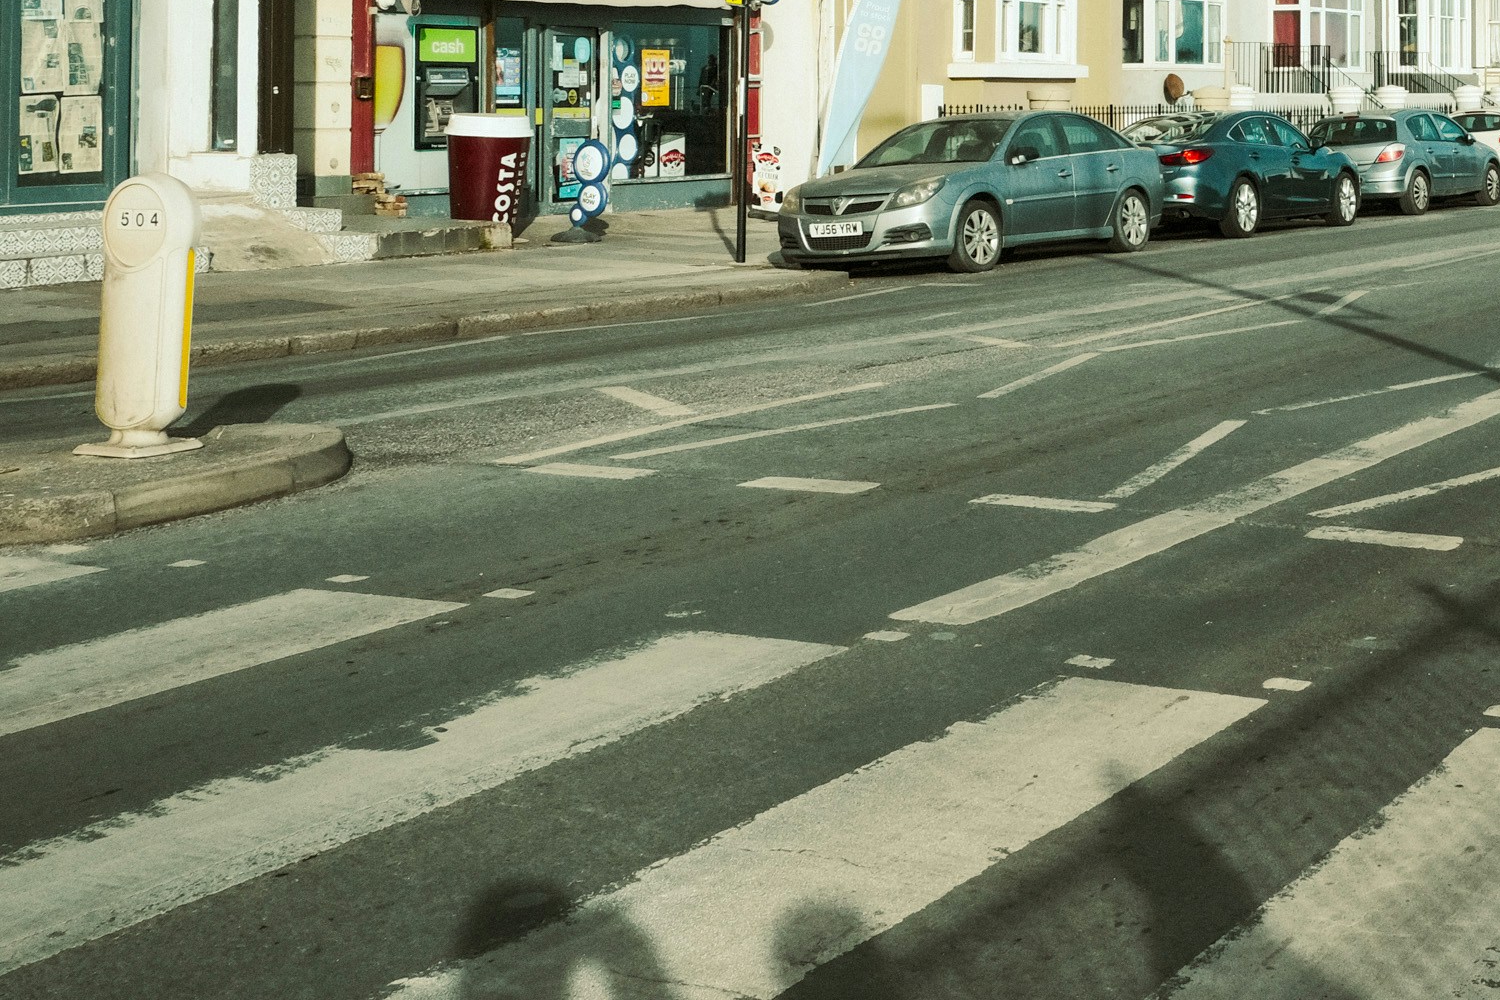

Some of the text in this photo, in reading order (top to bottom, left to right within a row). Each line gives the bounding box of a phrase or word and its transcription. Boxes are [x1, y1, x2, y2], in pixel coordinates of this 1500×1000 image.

[866, 1, 891, 13] Proud
[432, 37, 465, 54] cash
[492, 152, 517, 224] COSTA
[120, 211, 159, 227] 504
[814, 223, 858, 235] YJ56 YRW
